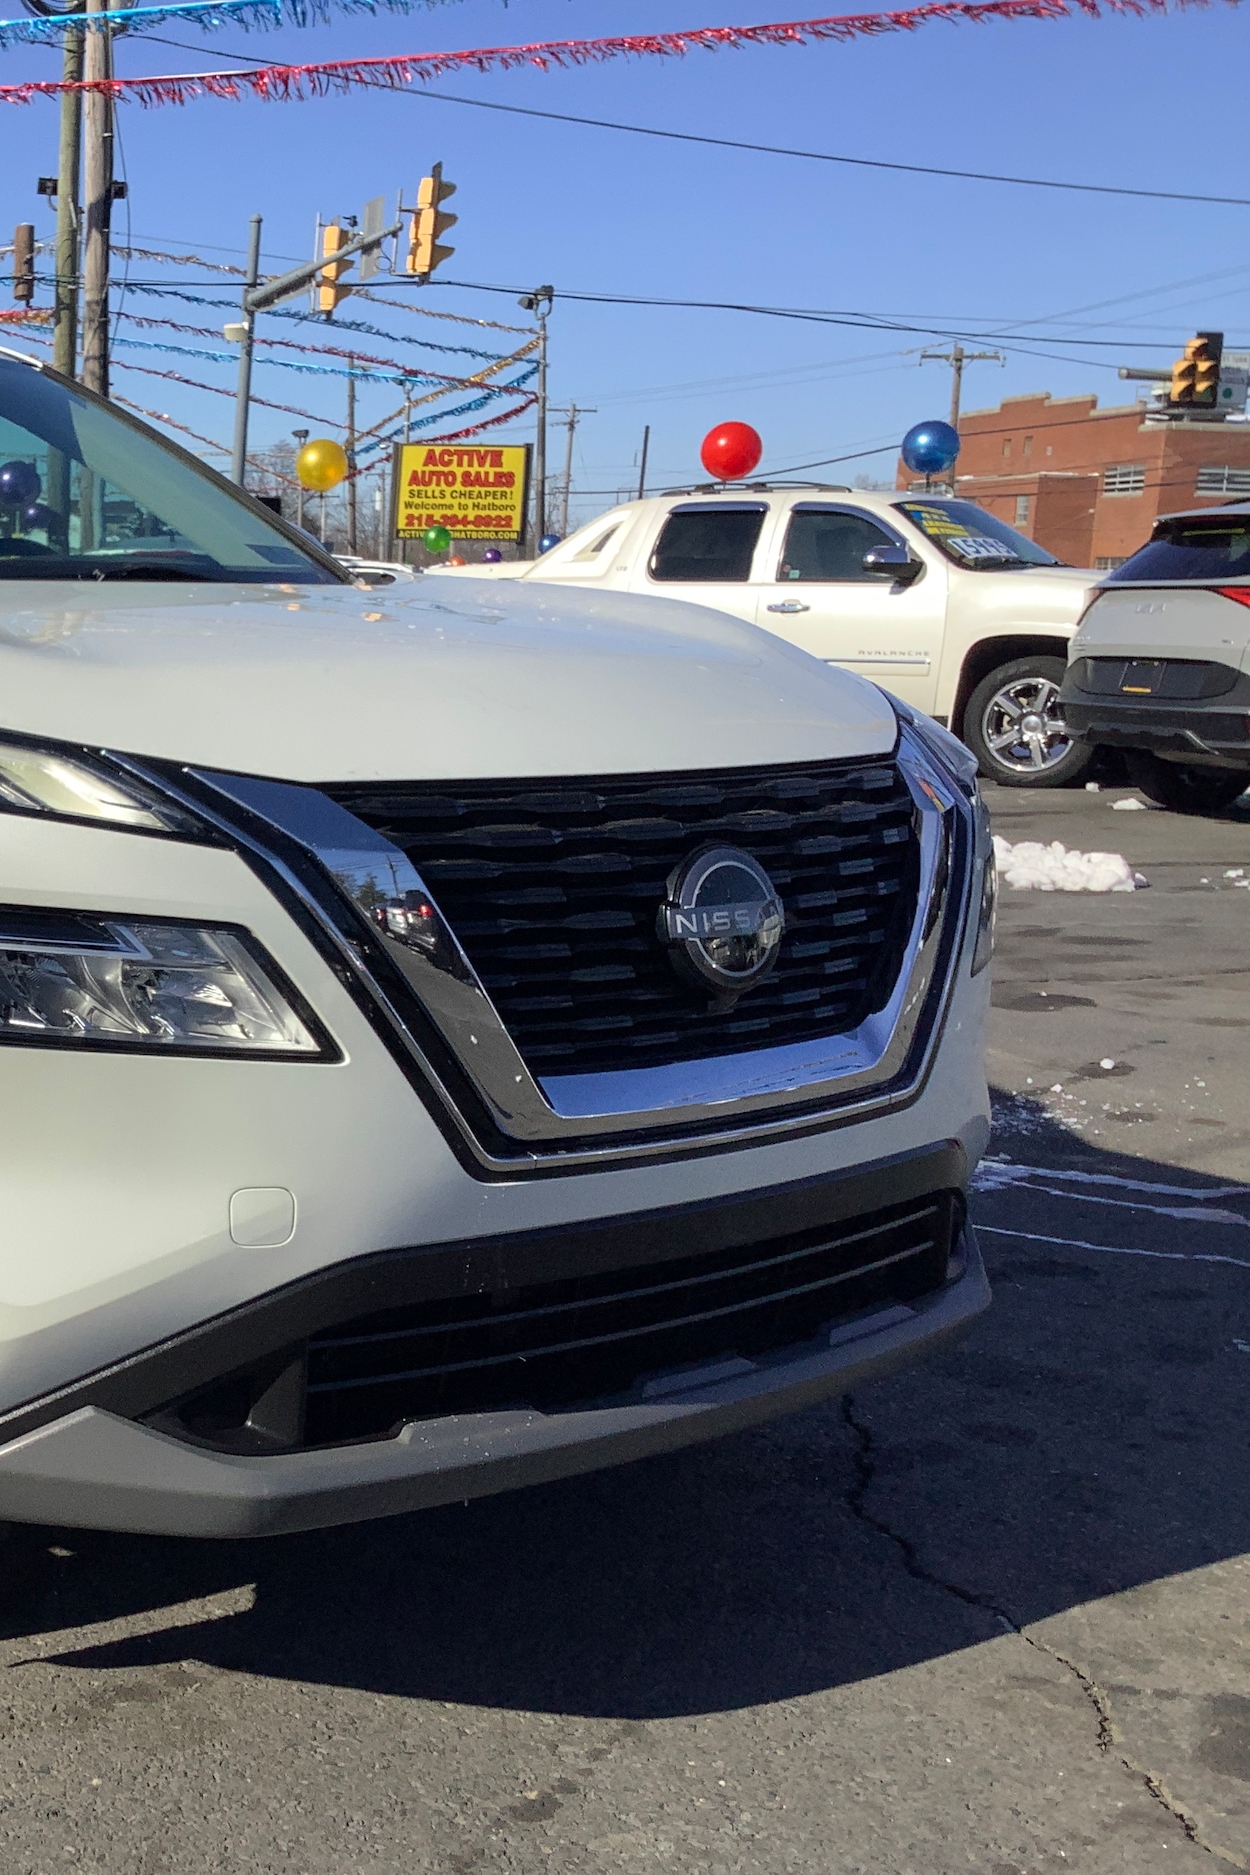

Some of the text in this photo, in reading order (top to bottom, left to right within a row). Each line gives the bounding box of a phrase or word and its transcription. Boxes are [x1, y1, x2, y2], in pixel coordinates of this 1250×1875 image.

[422, 449, 503, 468] ACTIVE
[407, 470, 516, 488] AUTO SALES
[408, 489, 513, 500] SELLS CHEAPER!
[404, 501, 516, 511] Welcome to Hatboro
[675, 908, 777, 934] NISS
